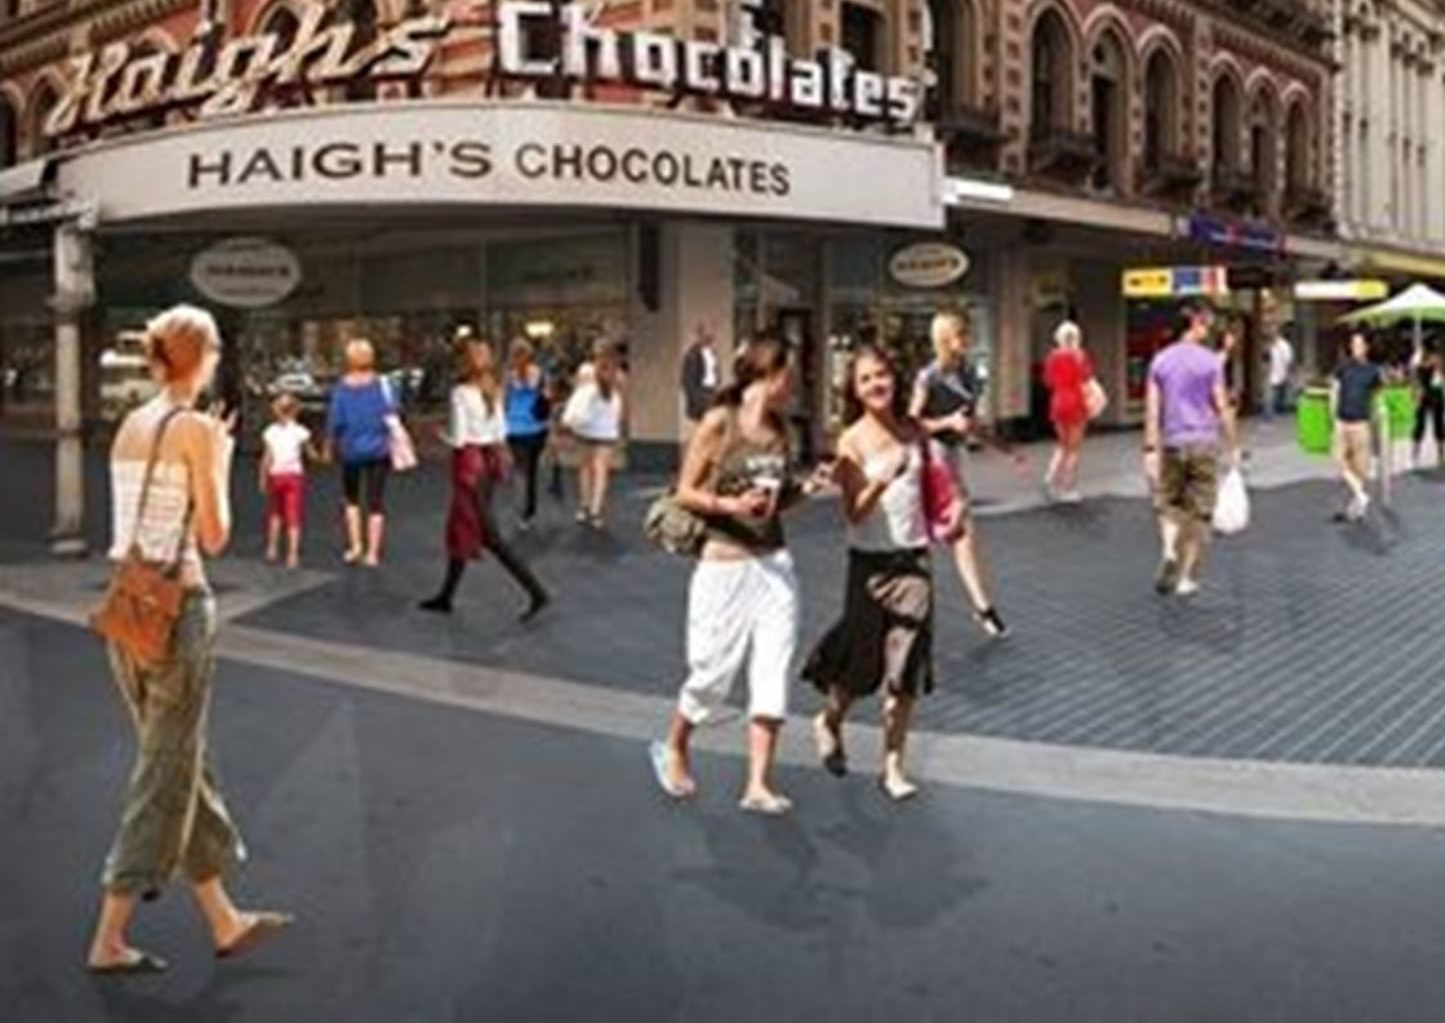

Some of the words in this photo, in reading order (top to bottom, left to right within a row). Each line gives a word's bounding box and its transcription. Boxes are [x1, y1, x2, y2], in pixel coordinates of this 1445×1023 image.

[498, 0, 922, 119] Chocolates
[188, 143, 493, 189] HAIGH'S
[515, 142, 790, 196] CHOCOLATES
